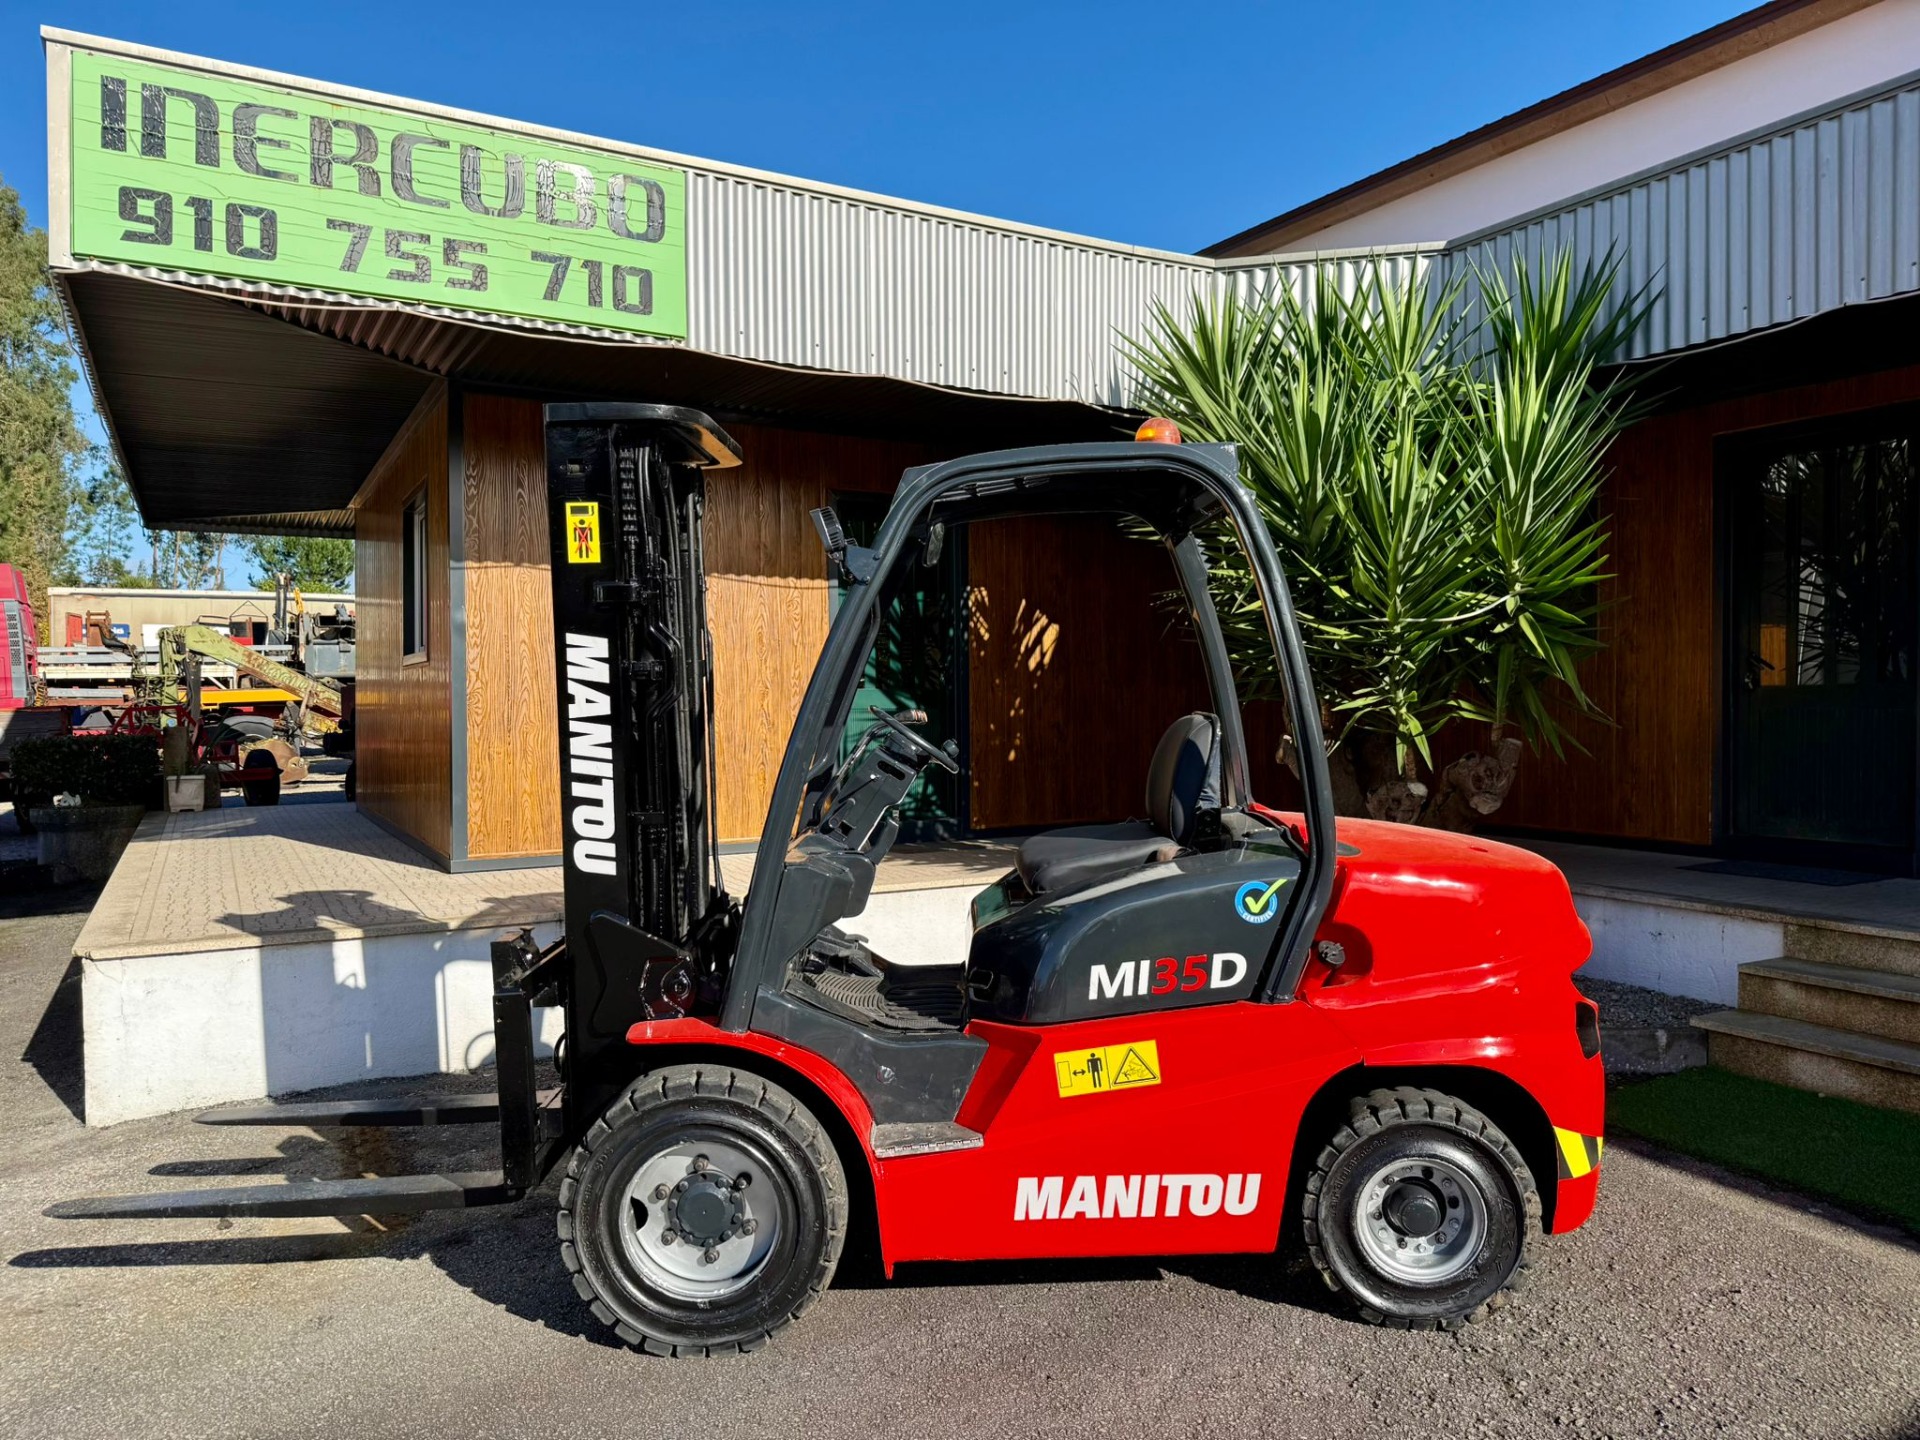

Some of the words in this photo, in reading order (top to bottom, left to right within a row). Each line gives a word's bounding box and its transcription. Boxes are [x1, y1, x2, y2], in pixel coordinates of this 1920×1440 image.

[100, 74, 666, 243] INERCUBO
[118, 185, 278, 261] 910
[326, 217, 488, 292] 755
[530, 250, 653, 315] 710
[565, 633, 617, 876] MANITOU
[1088, 952, 1247, 1001] MI35D
[1013, 1173, 1262, 1221] MANITOU
